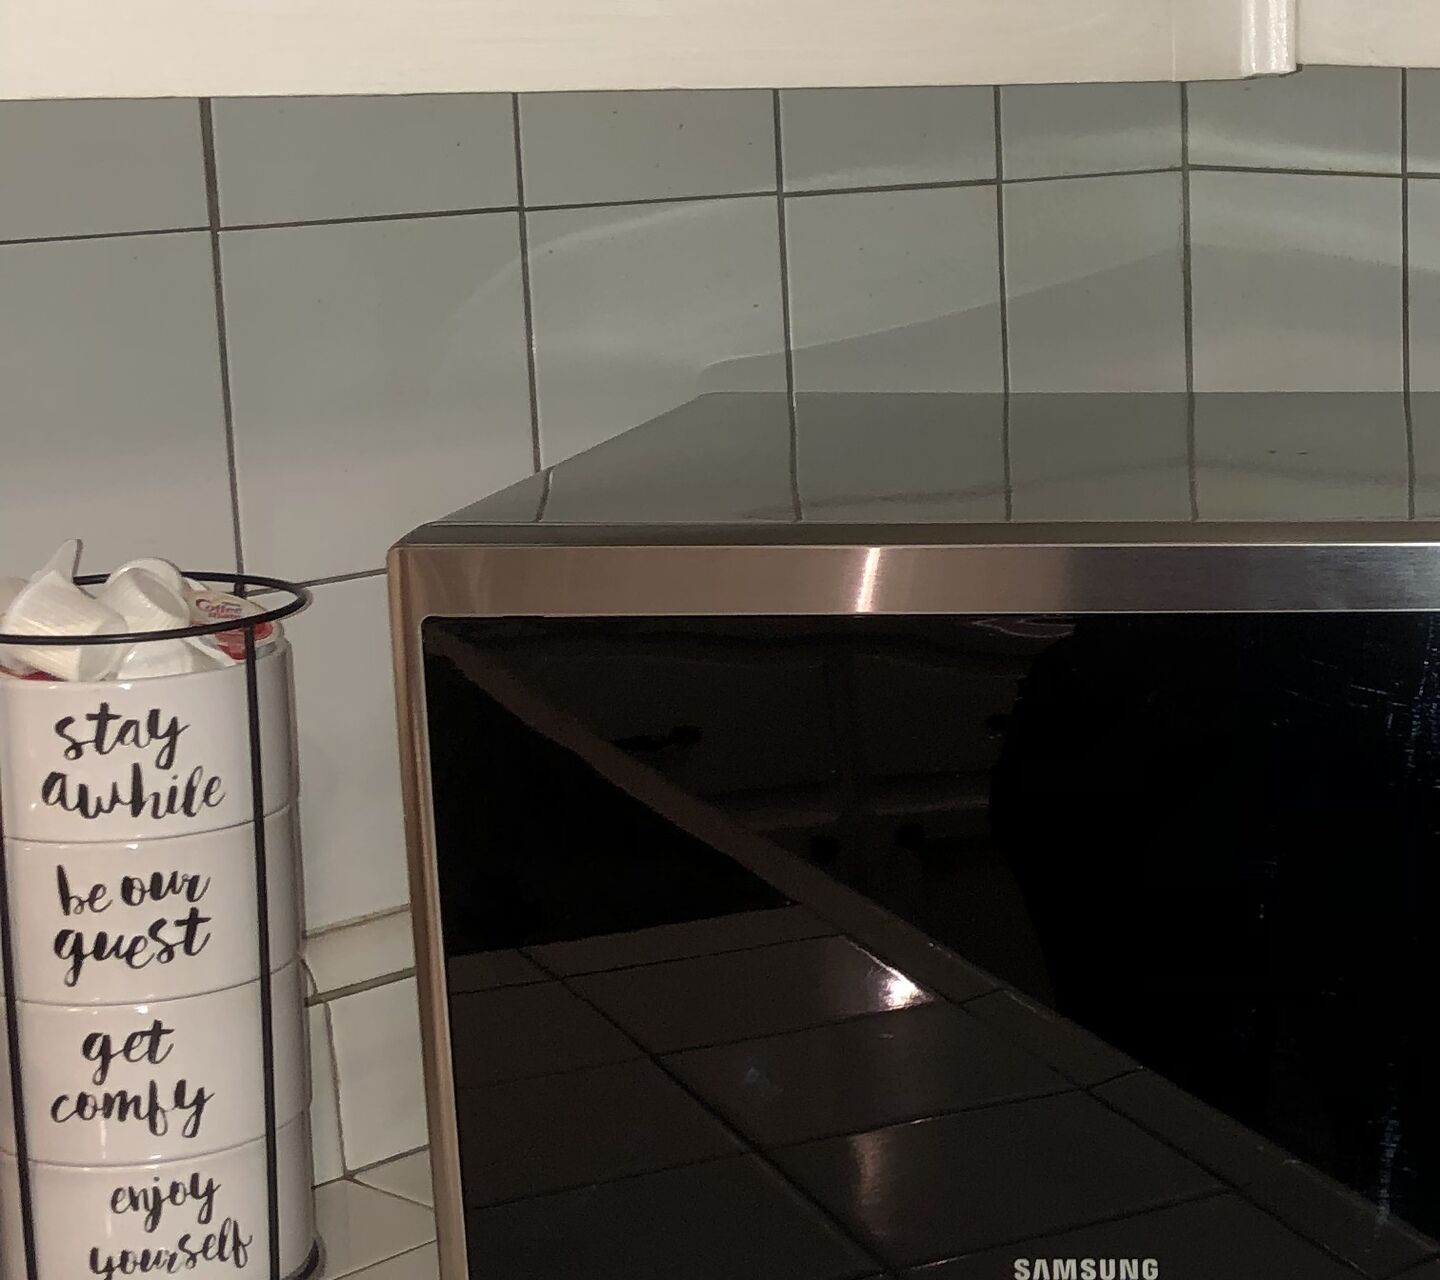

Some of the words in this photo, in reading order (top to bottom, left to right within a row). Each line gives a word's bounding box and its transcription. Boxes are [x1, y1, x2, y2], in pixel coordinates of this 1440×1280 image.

[55, 702, 190, 770] stay
[42, 762, 226, 820] awhile
[56, 864, 113, 916] be
[121, 871, 211, 906] our
[54, 907, 212, 987] guest
[82, 1020, 175, 1086] get
[51, 1079, 216, 1139] comfy
[111, 1173, 221, 1232] enjoy
